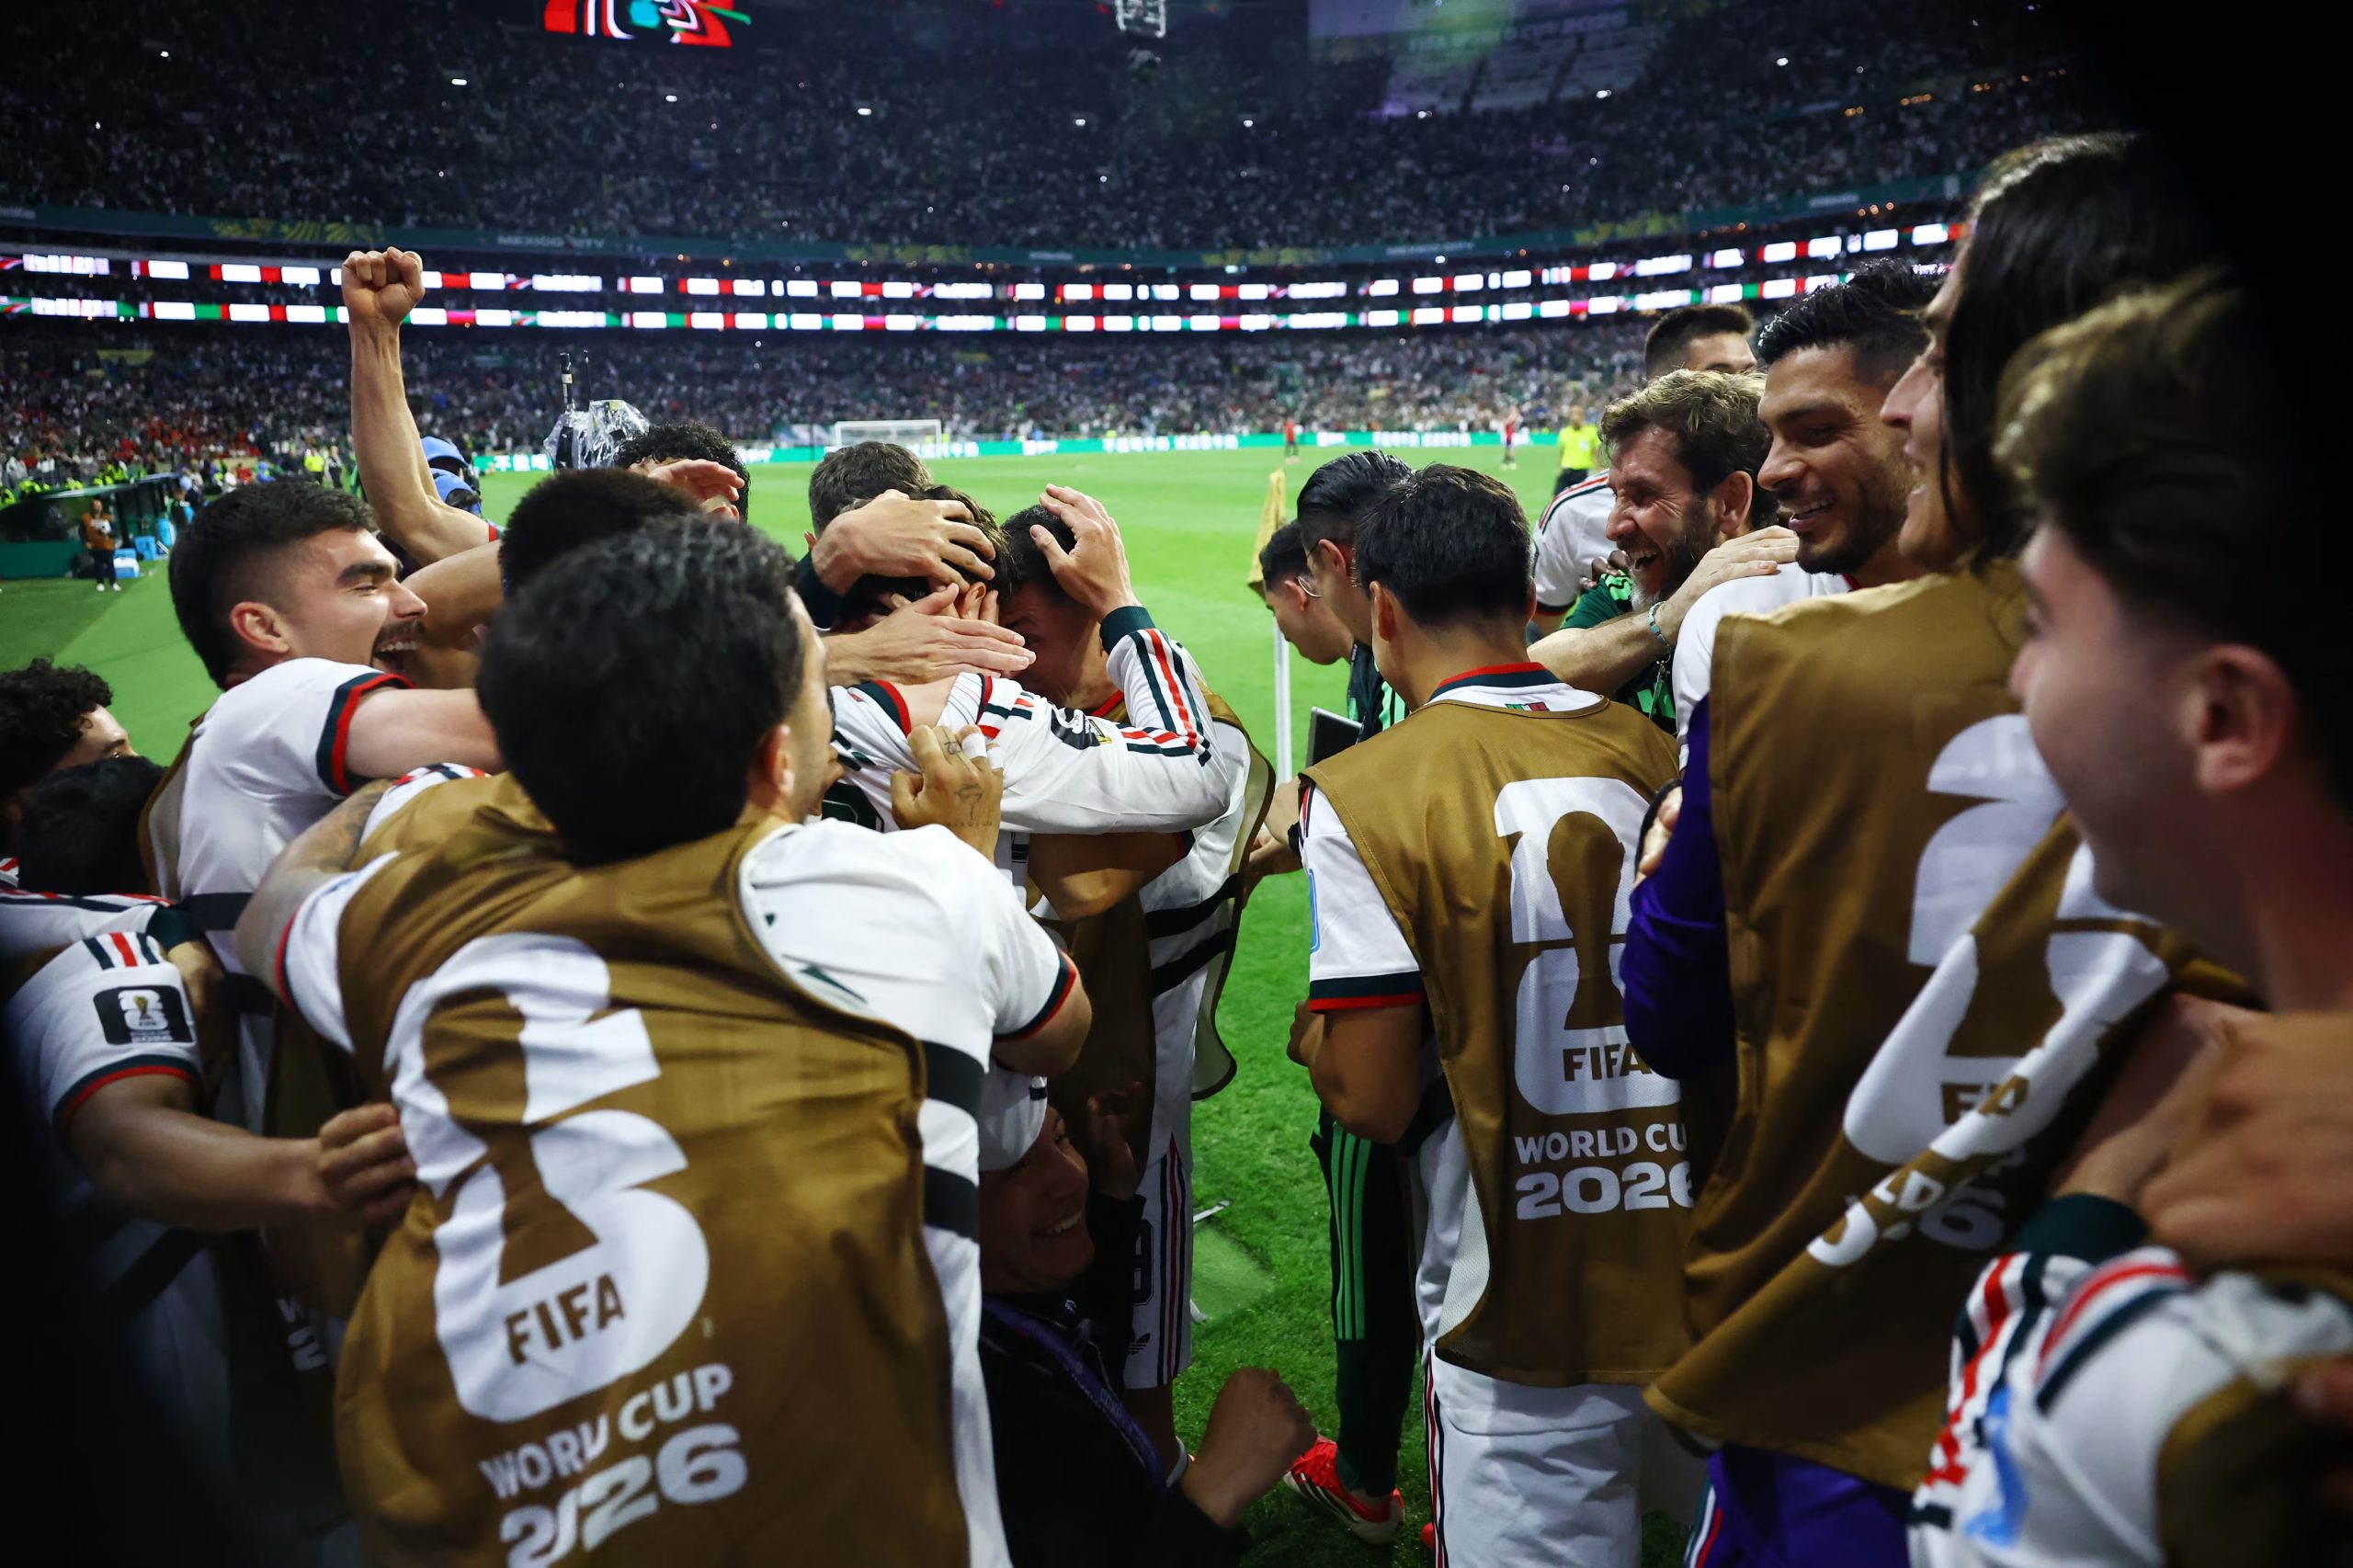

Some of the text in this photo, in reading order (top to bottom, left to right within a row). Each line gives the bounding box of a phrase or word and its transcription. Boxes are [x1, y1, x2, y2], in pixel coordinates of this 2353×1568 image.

[1563, 1042, 1653, 1082] FIFA
[1514, 1122, 1688, 1165] WORLD CU
[505, 1273, 624, 1366] FIFA
[618, 1362, 733, 1442] CUP
